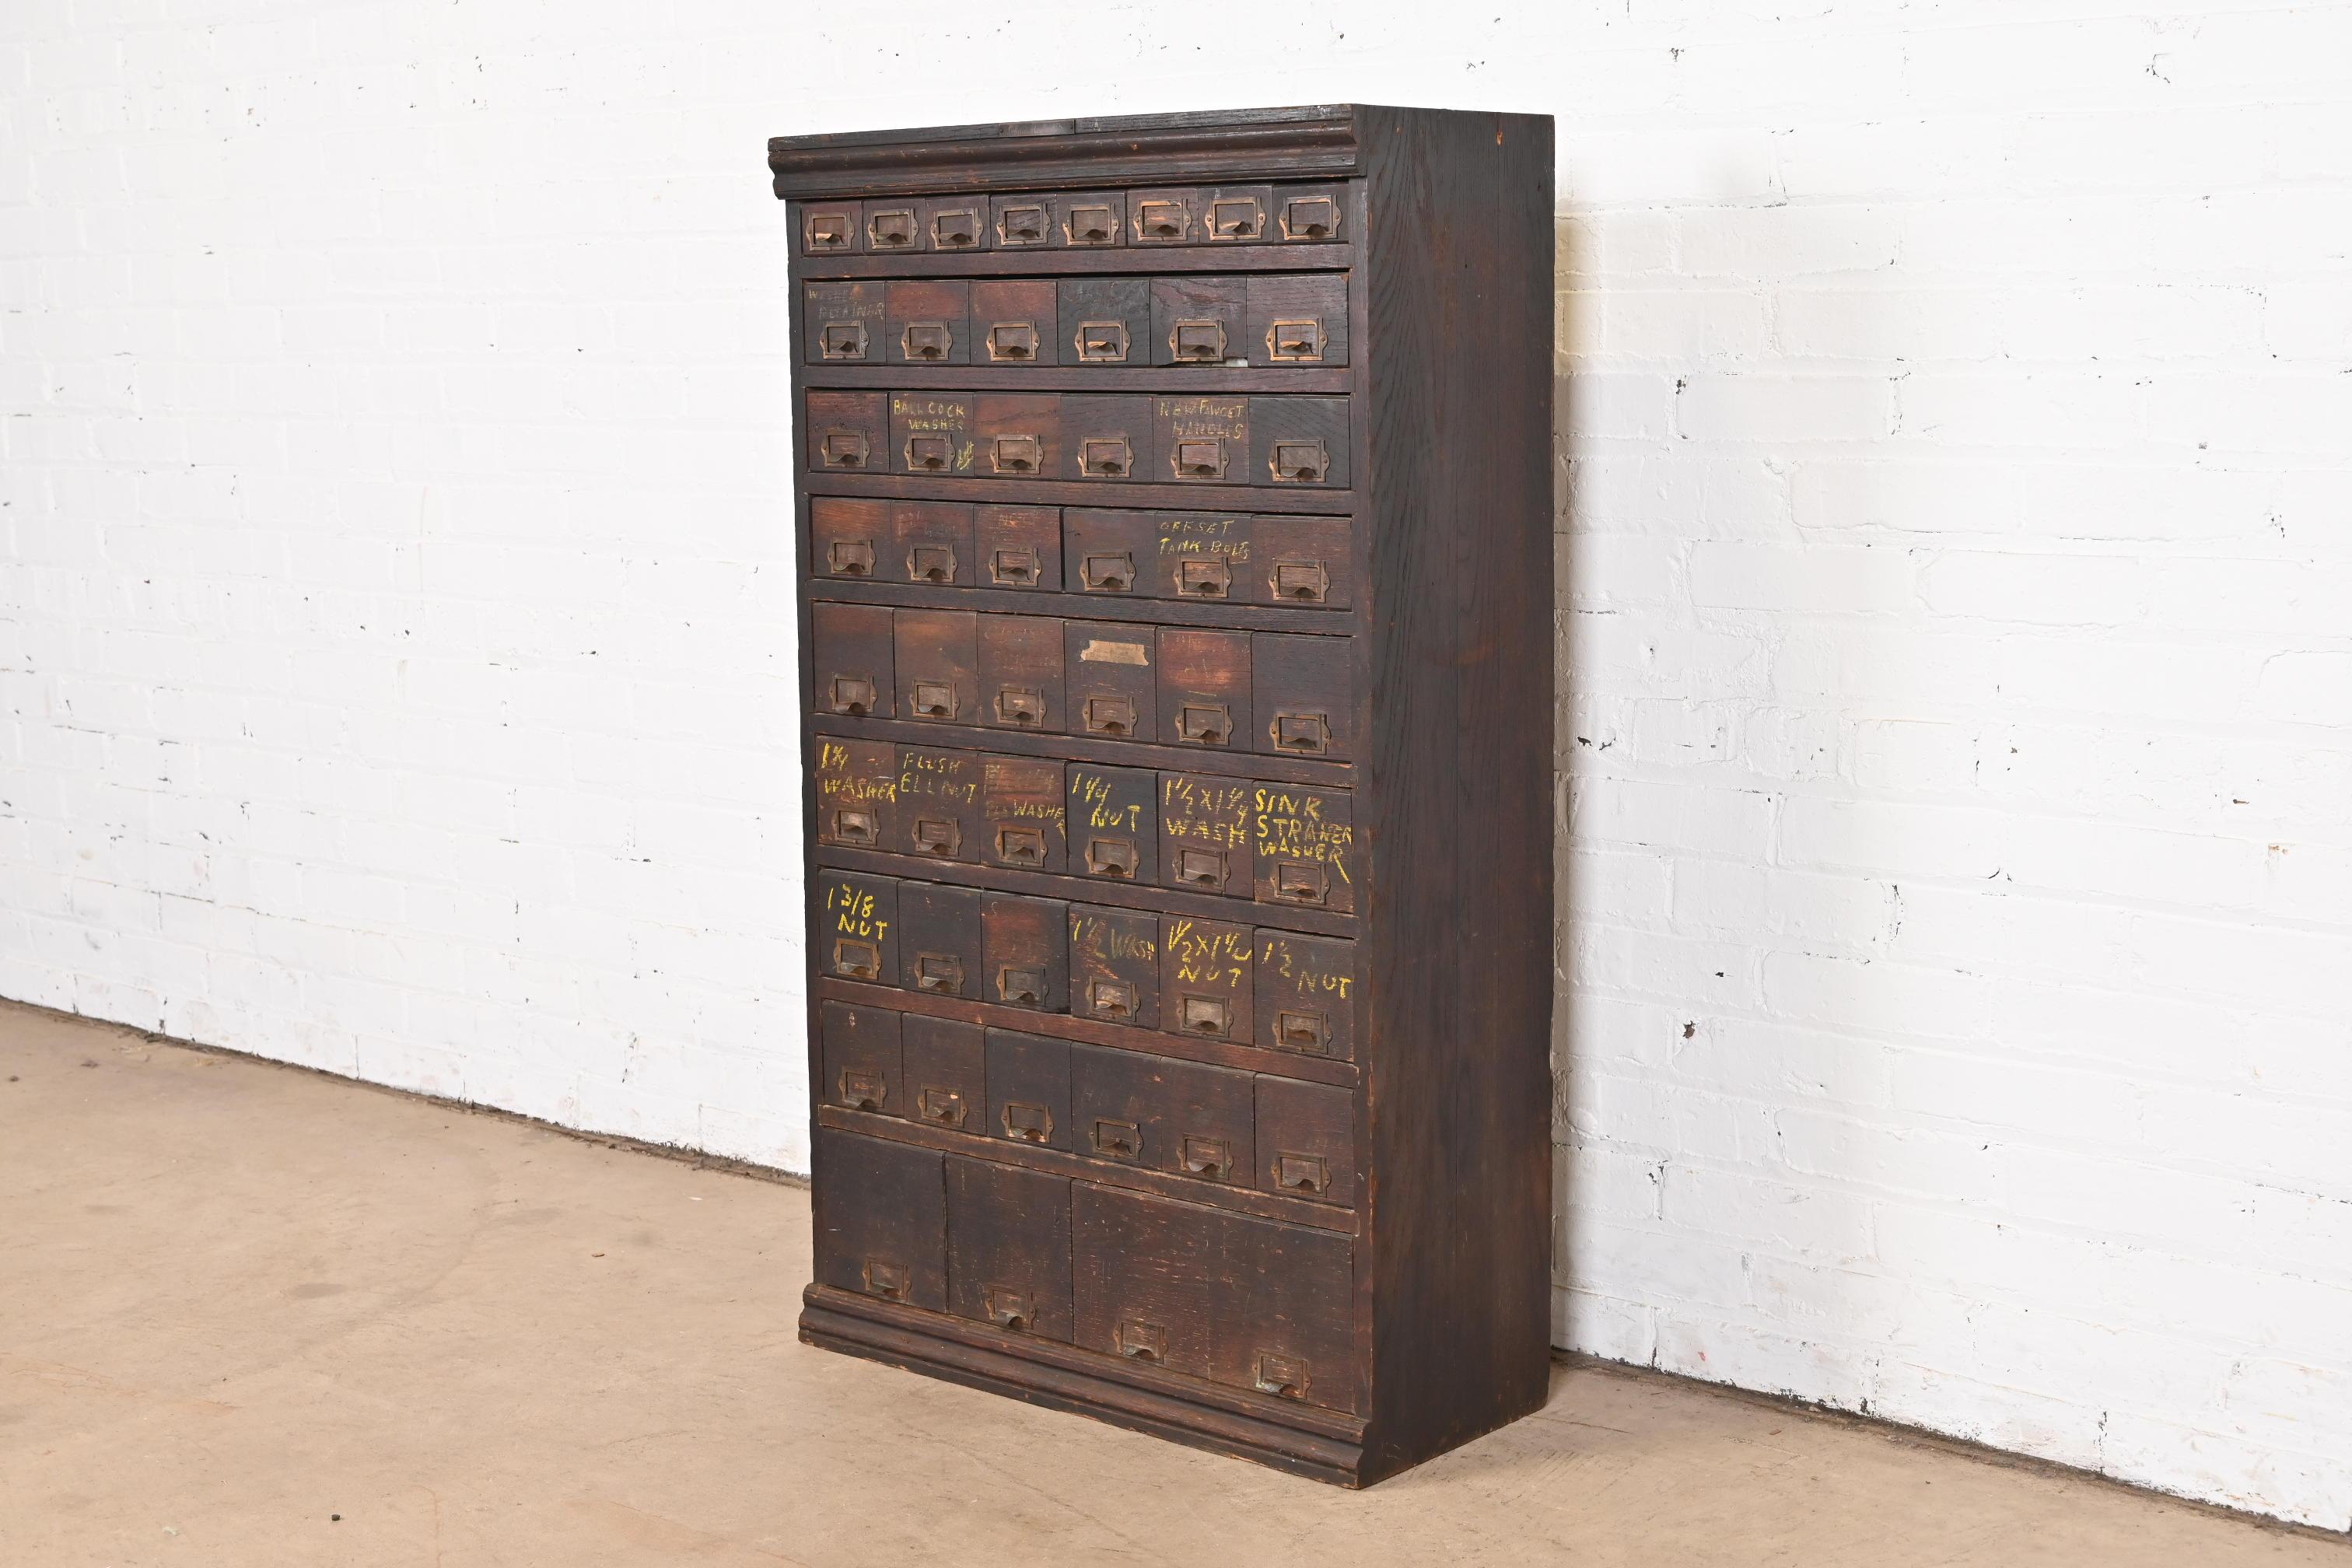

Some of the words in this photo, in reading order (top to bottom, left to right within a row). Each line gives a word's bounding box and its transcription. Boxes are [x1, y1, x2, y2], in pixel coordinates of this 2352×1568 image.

[928, 401, 965, 418] COCK
[1090, 804, 1142, 833] NUT
[1255, 788, 1324, 821] SINK
[1165, 817, 1248, 850] WASH
[837, 913, 888, 941] NUT
[1178, 964, 1242, 988] NUT
[1297, 970, 1353, 1000] NUT
